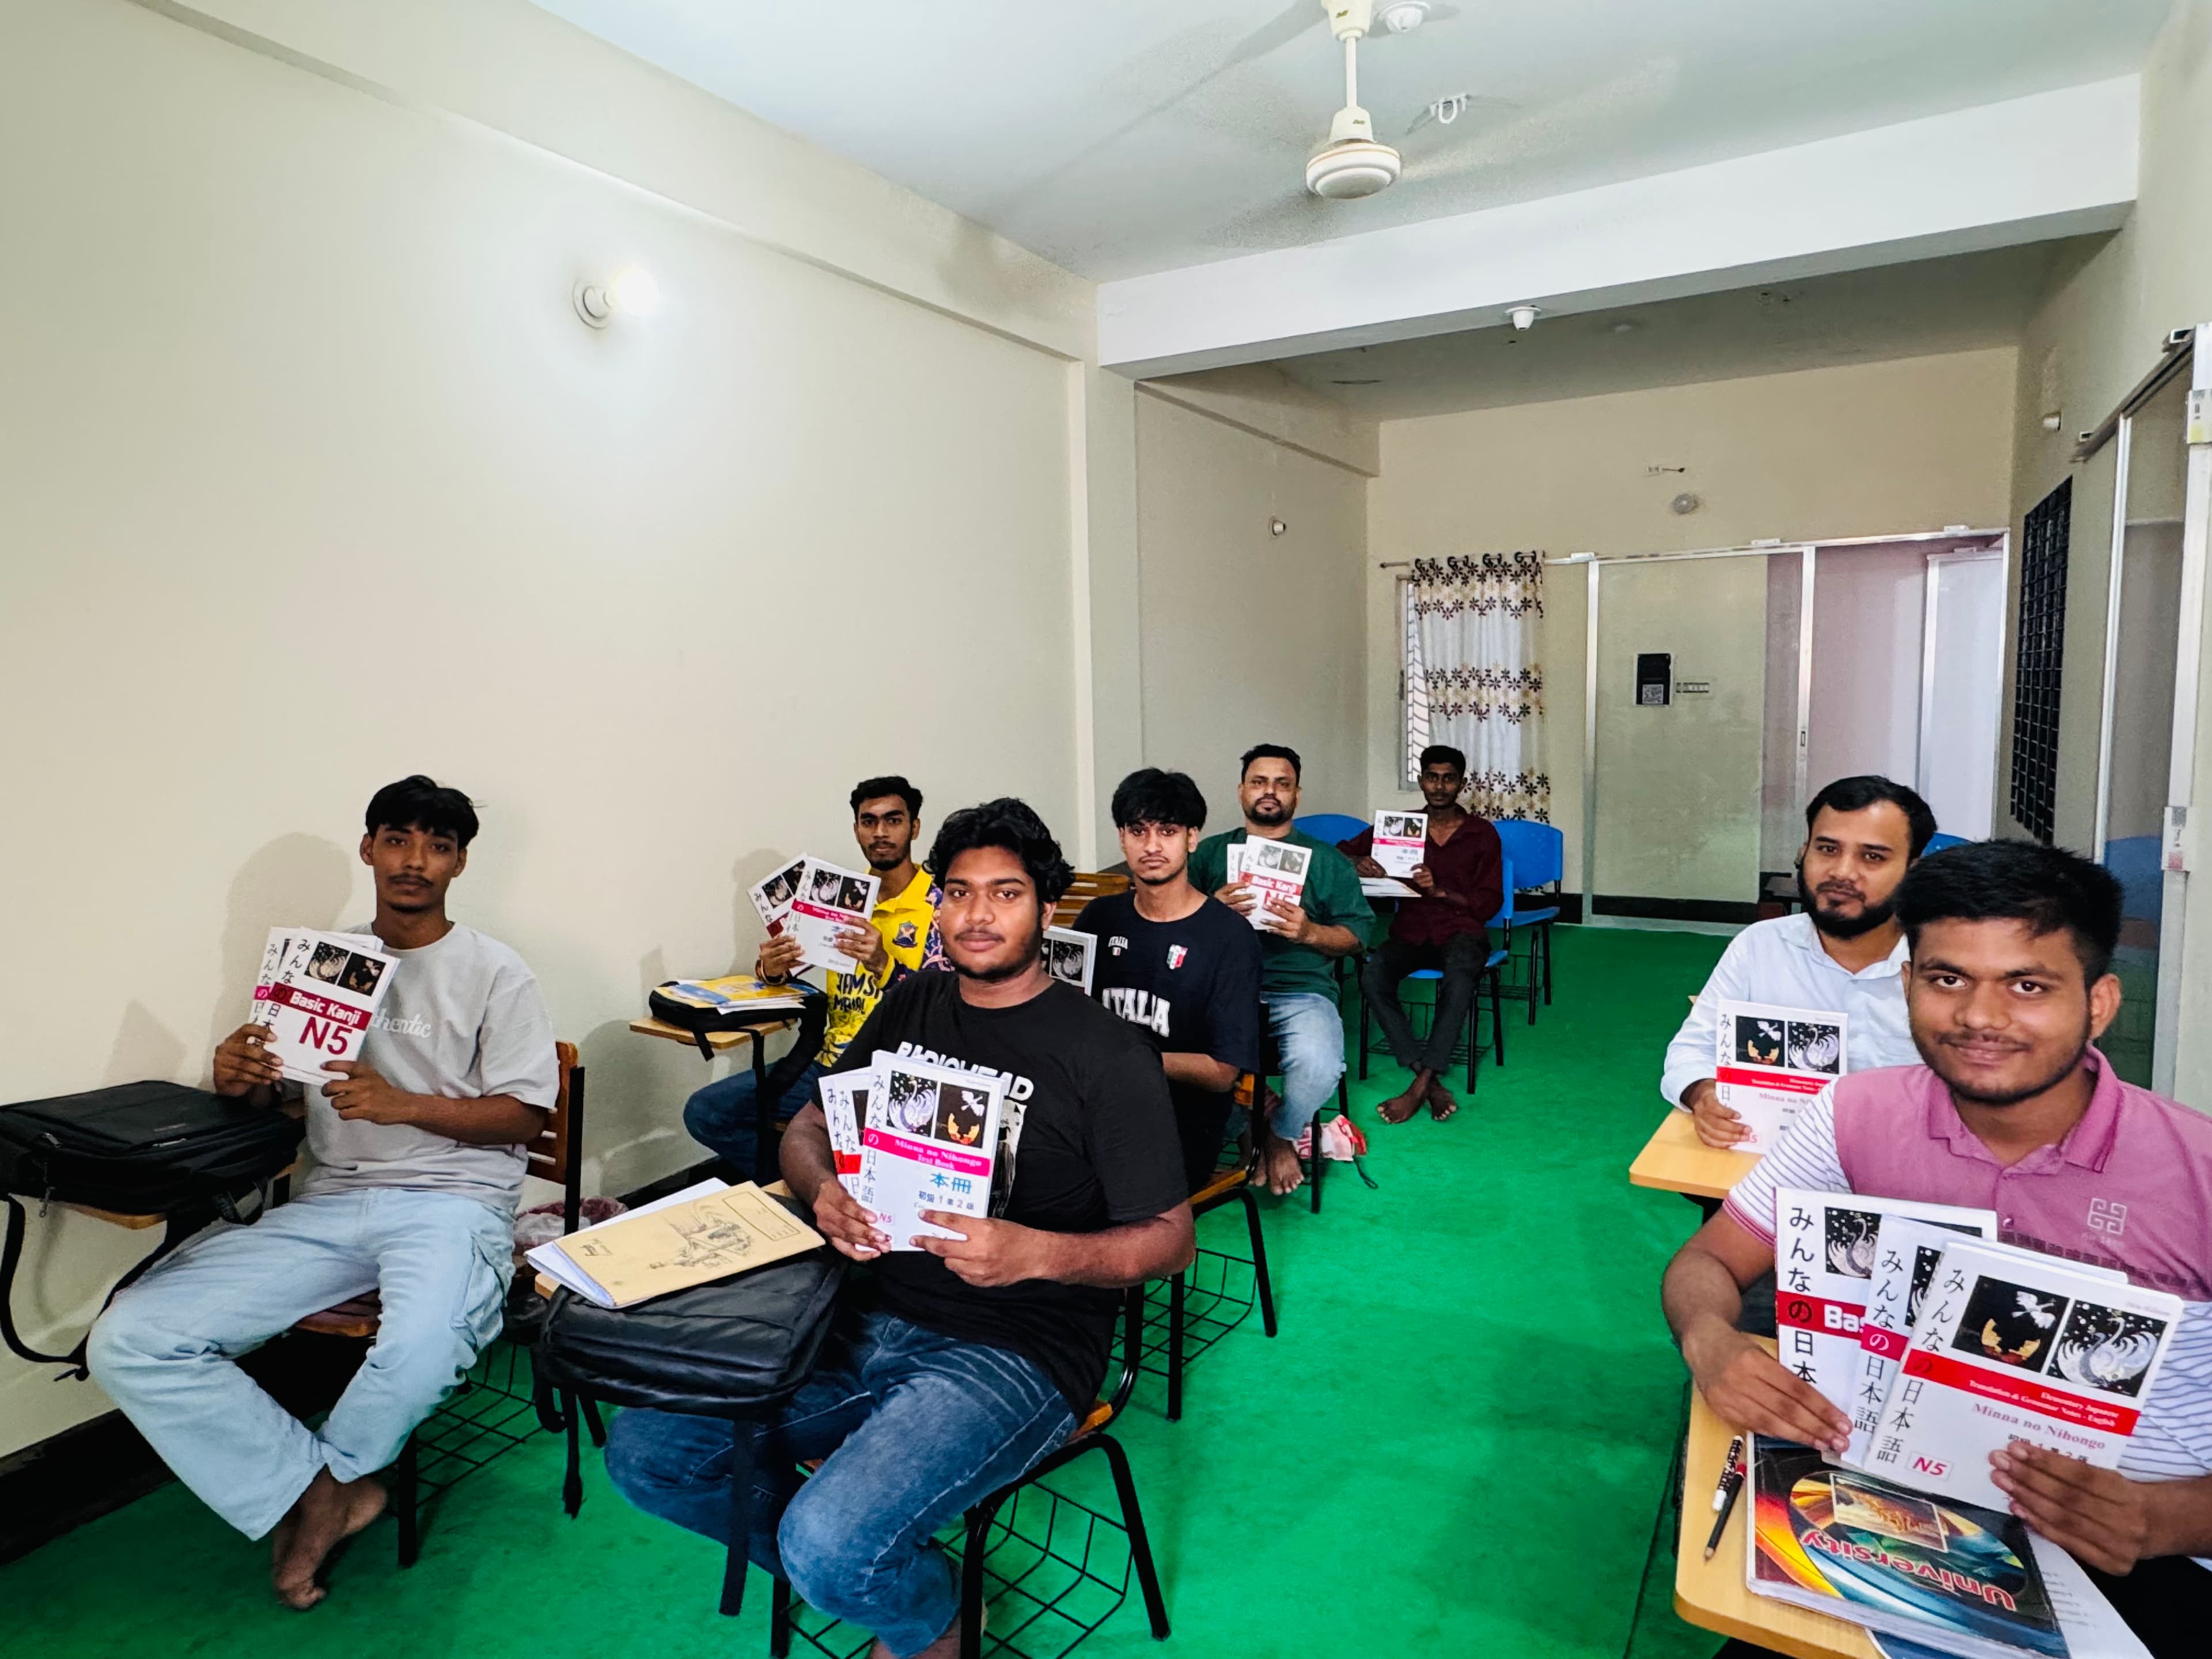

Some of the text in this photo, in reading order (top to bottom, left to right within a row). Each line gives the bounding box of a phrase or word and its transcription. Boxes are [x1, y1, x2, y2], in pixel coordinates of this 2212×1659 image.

[290, 990, 362, 1026] Basic Kanji
[1102, 987, 1171, 1037] ITALIA
[298, 1016, 353, 1055] N5
[895, 1139, 983, 1168] Minna no Nihongo
[917, 1153, 956, 1171] Text Book
[1824, 1303, 1865, 1334] Ba
[1876, 1268, 1965, 1464] みんなの日本語
[1972, 1402, 2020, 1425] Minna
[2022, 1419, 2042, 1431] no
[2046, 1425, 2106, 1450] Nihongo
[1912, 1457, 1948, 1476] N5
[1801, 1529, 2017, 1612] University
